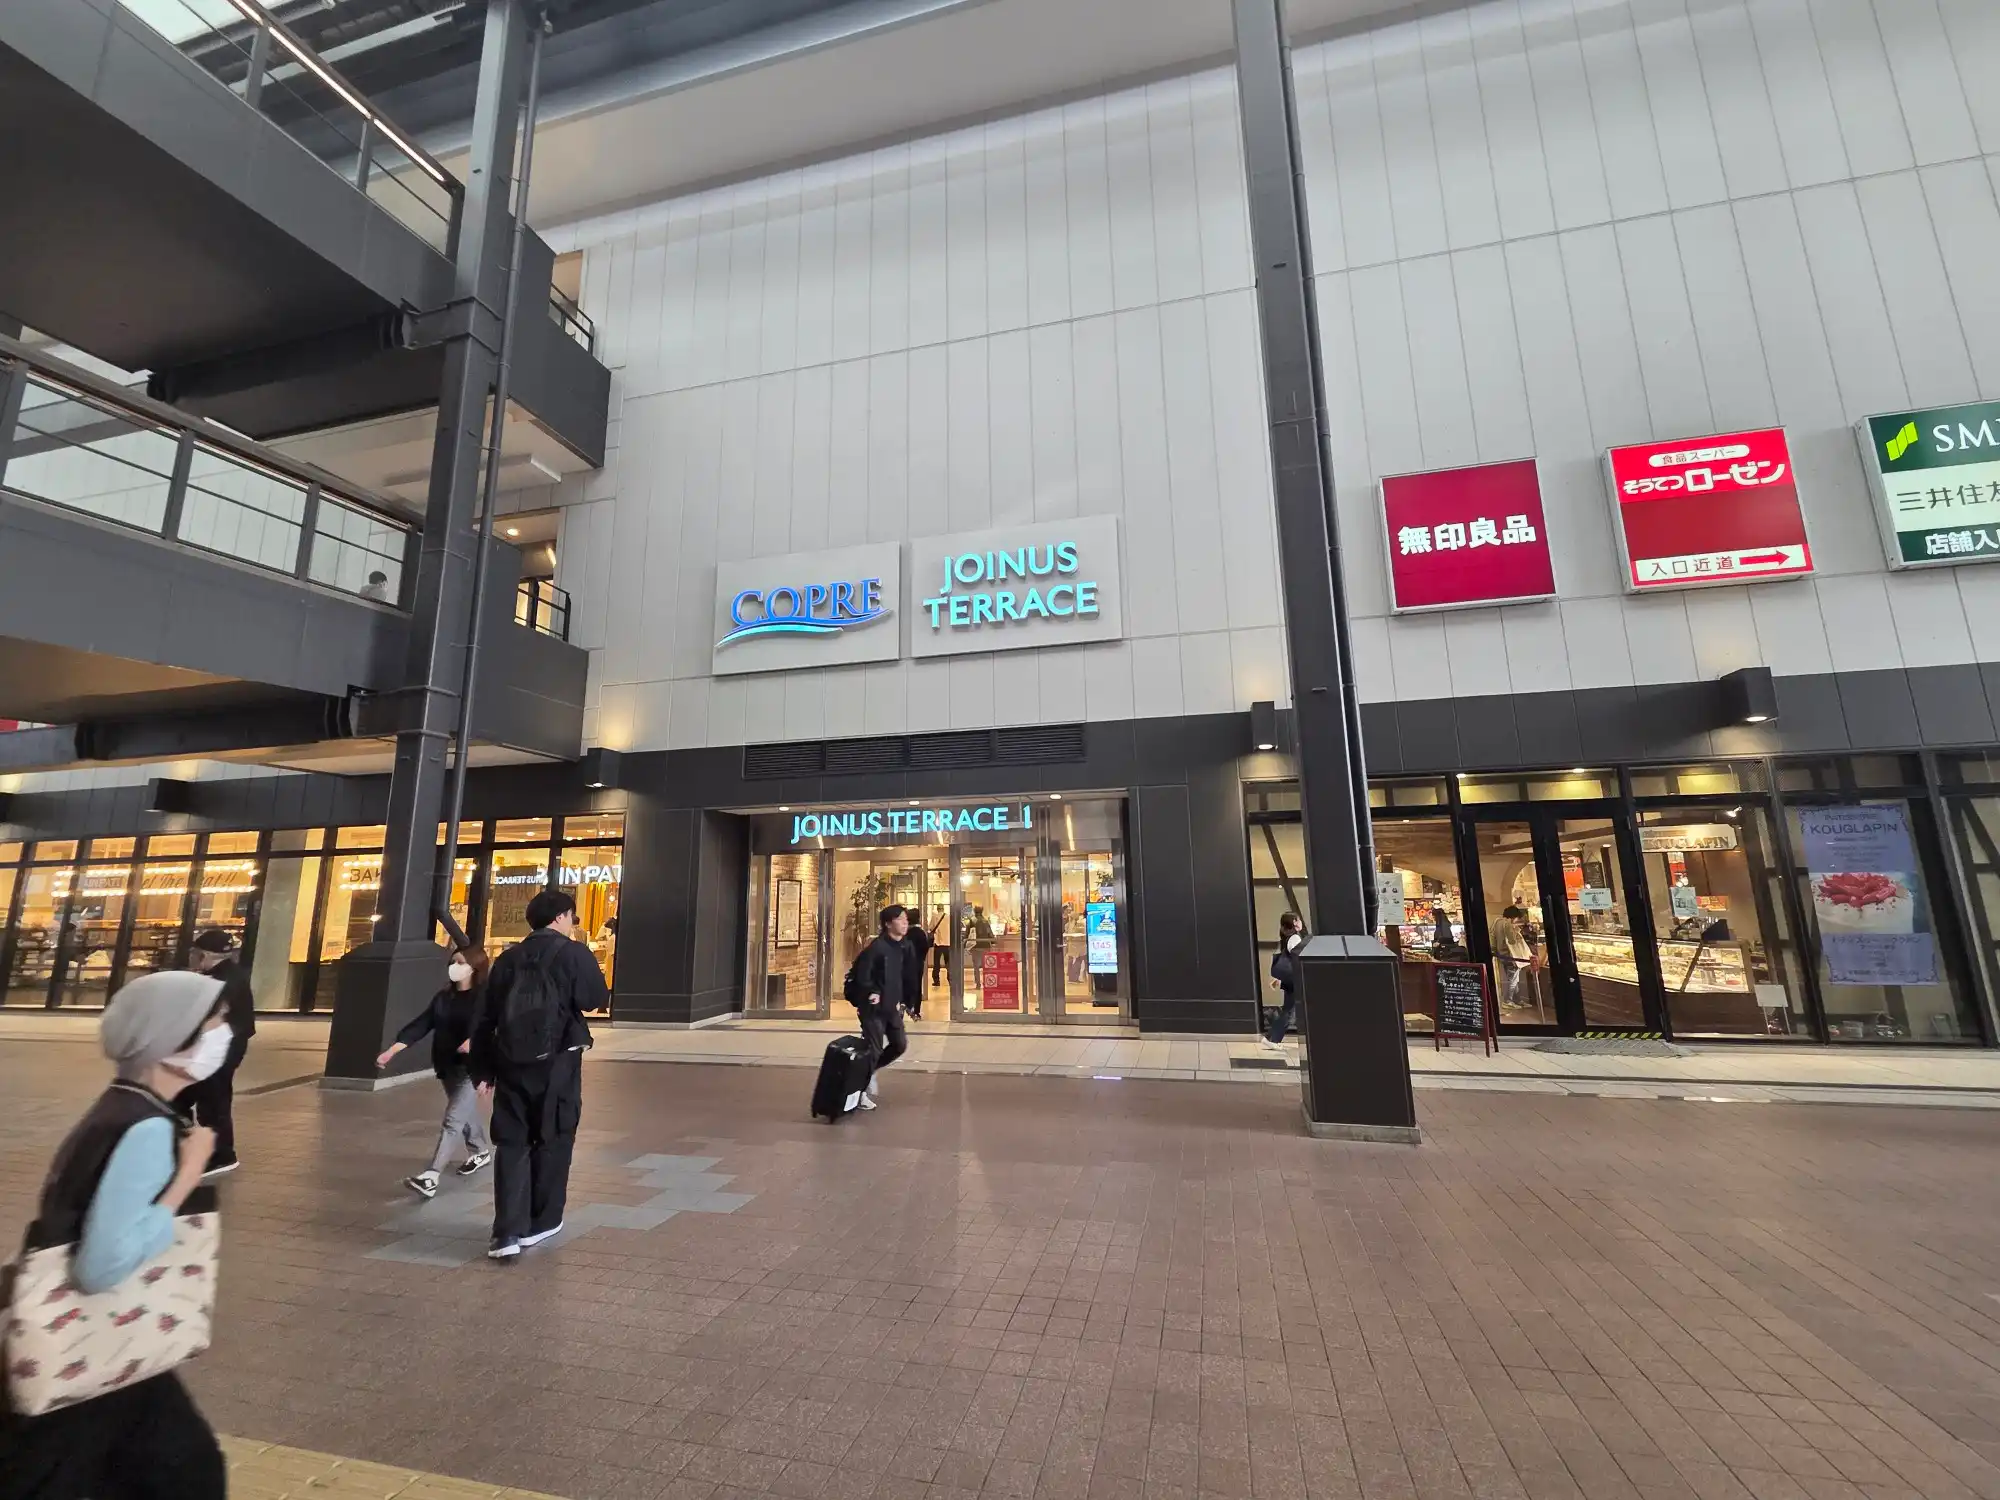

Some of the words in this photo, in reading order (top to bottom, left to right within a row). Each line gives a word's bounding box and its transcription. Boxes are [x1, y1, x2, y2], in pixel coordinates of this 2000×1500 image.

[1932, 418, 2000, 453] SM
[1661, 447, 1738, 465] 食品スーパー
[1623, 460, 1786, 494] そうてつローゼン
[1398, 514, 1537, 556] 無印良品
[1925, 529, 2000, 555] 店舗入
[939, 540, 1079, 595] JOINUS
[1651, 556, 1735, 577] 入口近道
[731, 577, 886, 627] COPRE
[922, 581, 1099, 629] TERRACE
[791, 813, 883, 845] JOINUS
[888, 807, 1009, 833] TERRACE
[1022, 805, 1032, 829] 1
[1808, 823, 1899, 835] KOUGLAPIN
